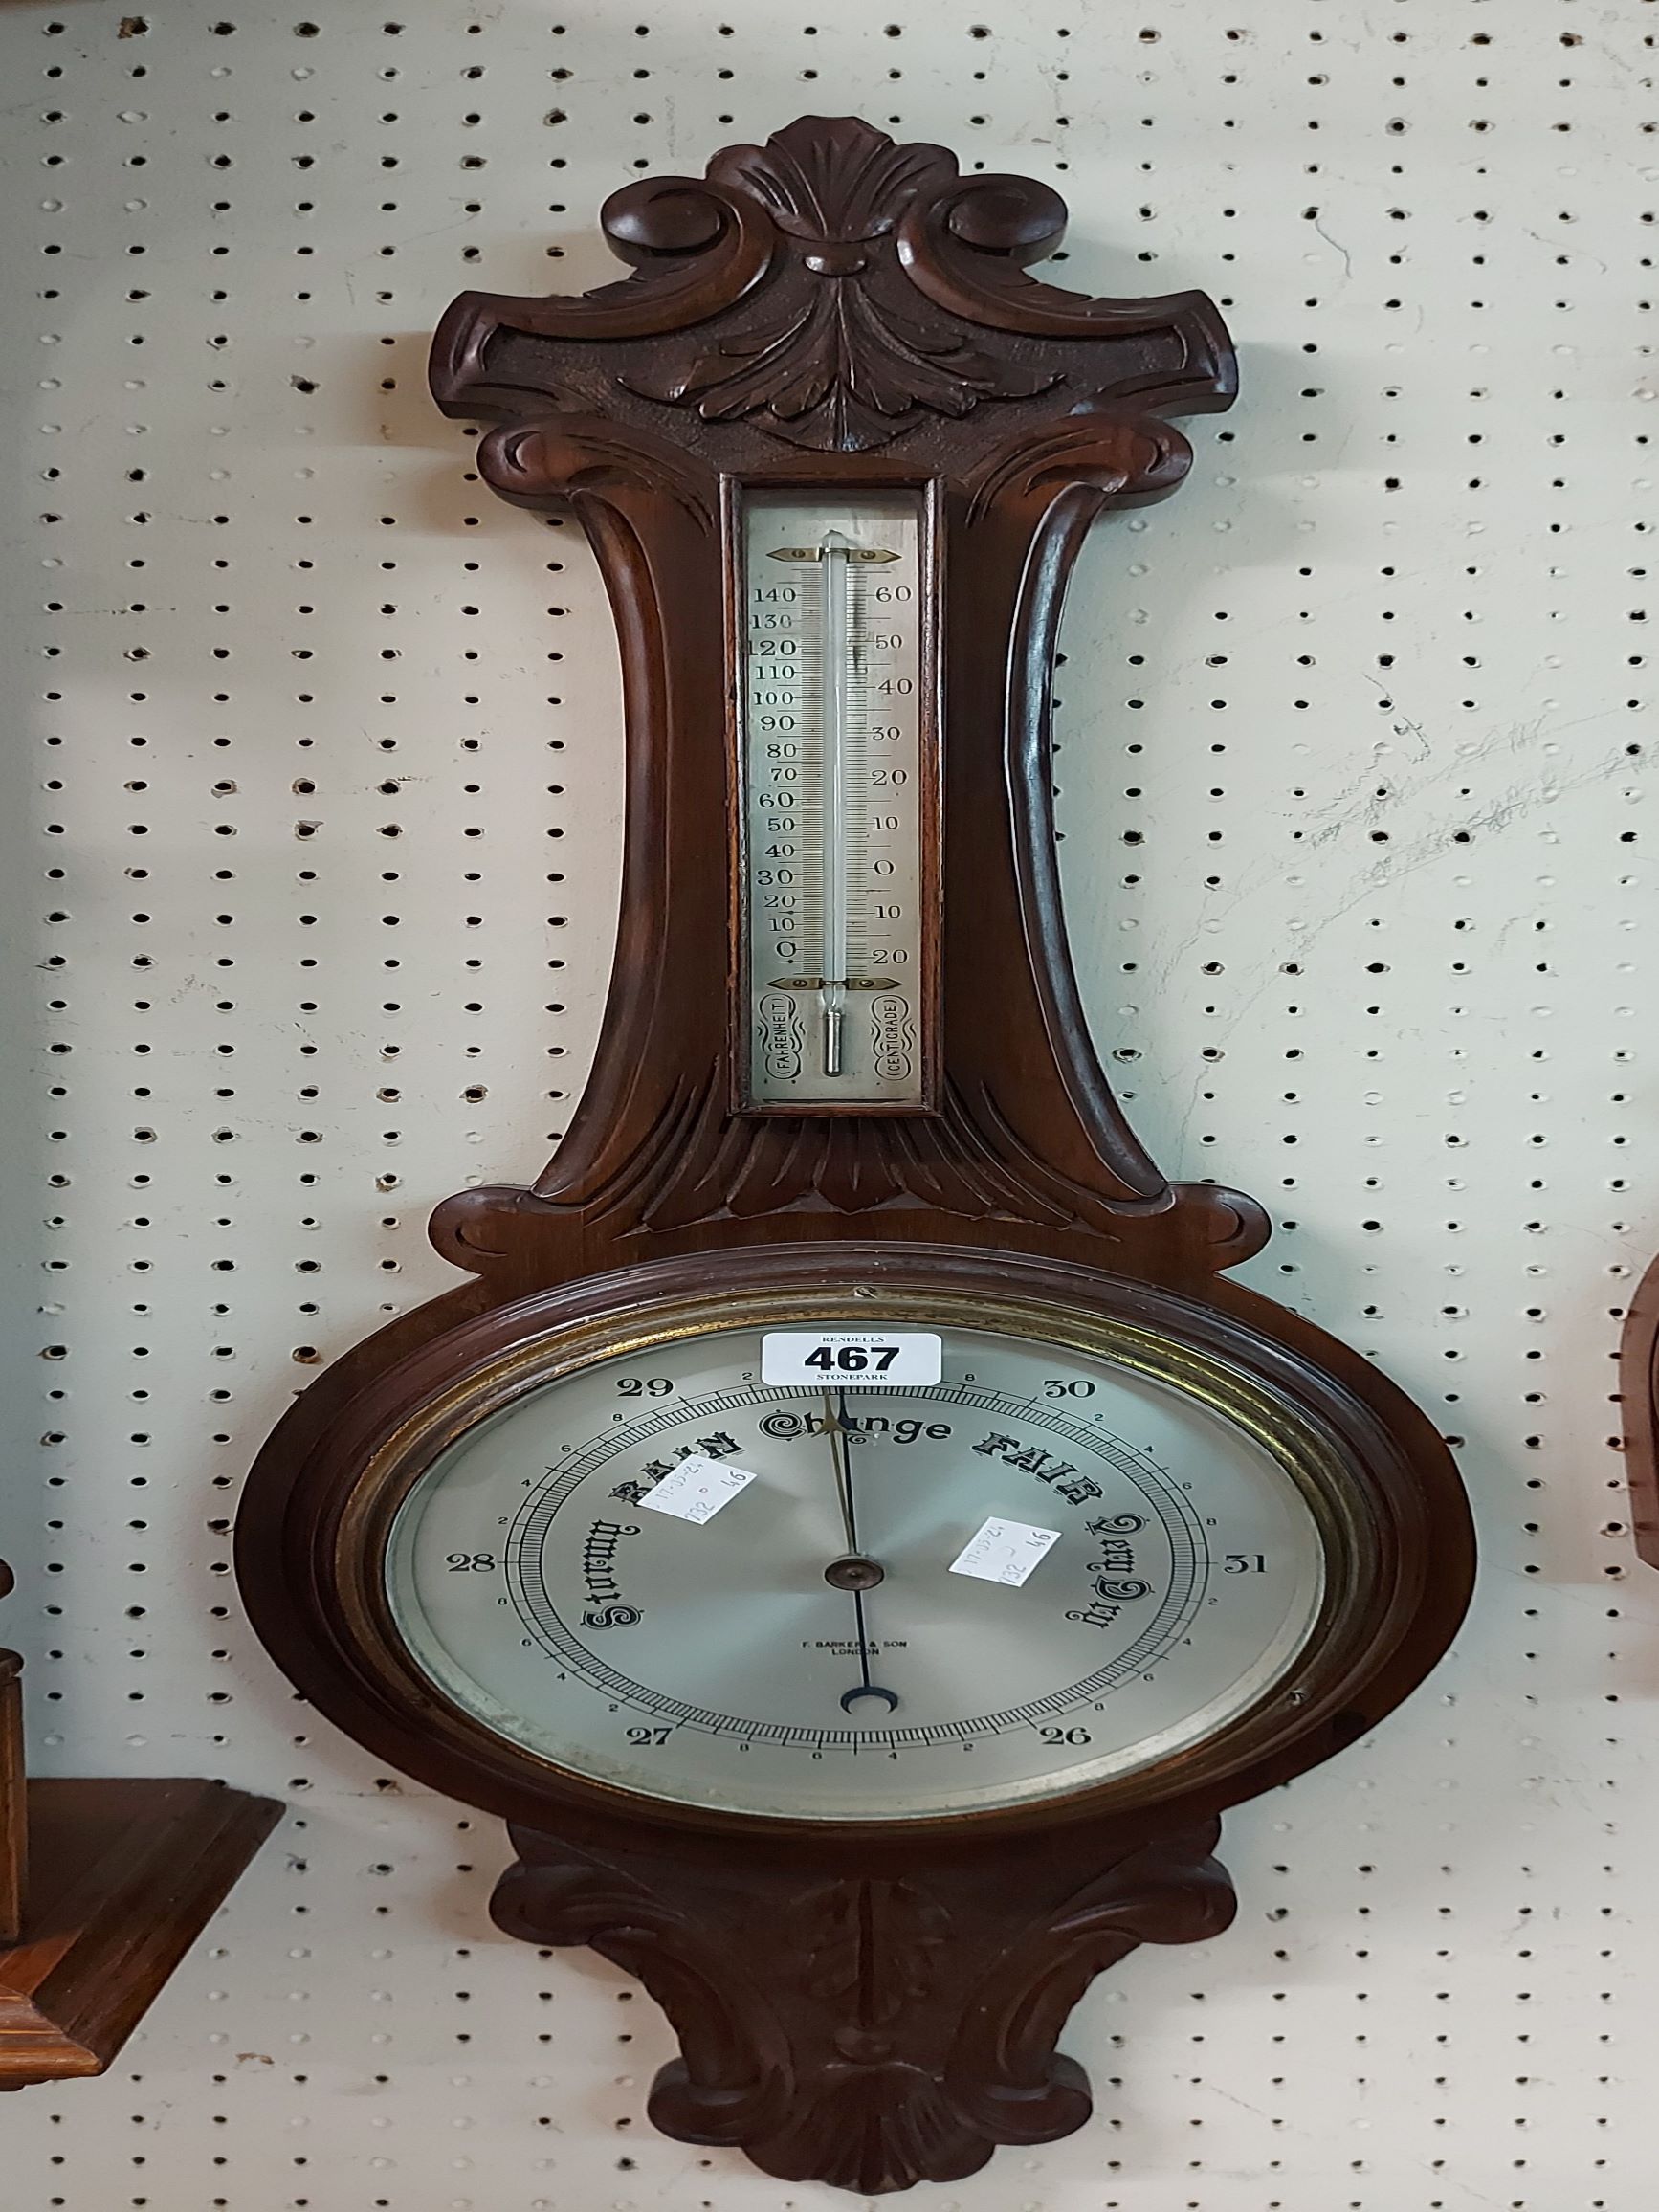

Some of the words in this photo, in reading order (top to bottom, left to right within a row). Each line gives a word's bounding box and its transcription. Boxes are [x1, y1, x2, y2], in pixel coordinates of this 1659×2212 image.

[754, 587, 796, 603] 140
[875, 586, 912, 602] 60
[752, 614, 792, 629] 130
[748, 640, 796, 656] 120
[875, 634, 902, 649] 50
[755, 665, 795, 680] 110
[877, 678, 913, 695] 40
[753, 691, 793, 705] 100
[760, 715, 795, 731] 90
[872, 726, 900, 741] 30
[766, 743, 796, 758] 80
[770, 768, 797, 781] 70
[872, 769, 907, 785] 20
[759, 792, 794, 808] 60
[767, 818, 795, 831] 50
[873, 816, 898, 830] 10
[765, 844, 795, 858] 40
[757, 869, 793, 885] 30
[764, 895, 796, 908] 20
[874, 905, 901, 919] 10
[768, 918, 795, 932] 10
[872, 949, 908, 964] 20
[804, 1346, 900, 1371] 467
[742, 1372, 752, 1381] 2
[965, 1373, 975, 1382] 8
[616, 1378, 674, 1397] 29
[1044, 1380, 1095, 1398] 30
[1095, 1413, 1104, 1422] 2
[561, 1444, 571, 1452] 6
[1144, 1445, 1154, 1453] 4
[971, 1432, 1103, 1505] FAIR
[720, 1471, 747, 1487] 46
[498, 1516, 509, 1525] 2
[1026, 1532, 1051, 1547] 46
[446, 1554, 496, 1572] 28
[1224, 1554, 1267, 1573] 31
[580, 1519, 645, 1630] Stormy
[1183, 1637, 1192, 1646] 4
[557, 1672, 566, 1681] 4
[1143, 1673, 1154, 1682] 6
[626, 1727, 673, 1745] 27
[1039, 1727, 1091, 1745] 26
[888, 1752, 897, 1760] 4
